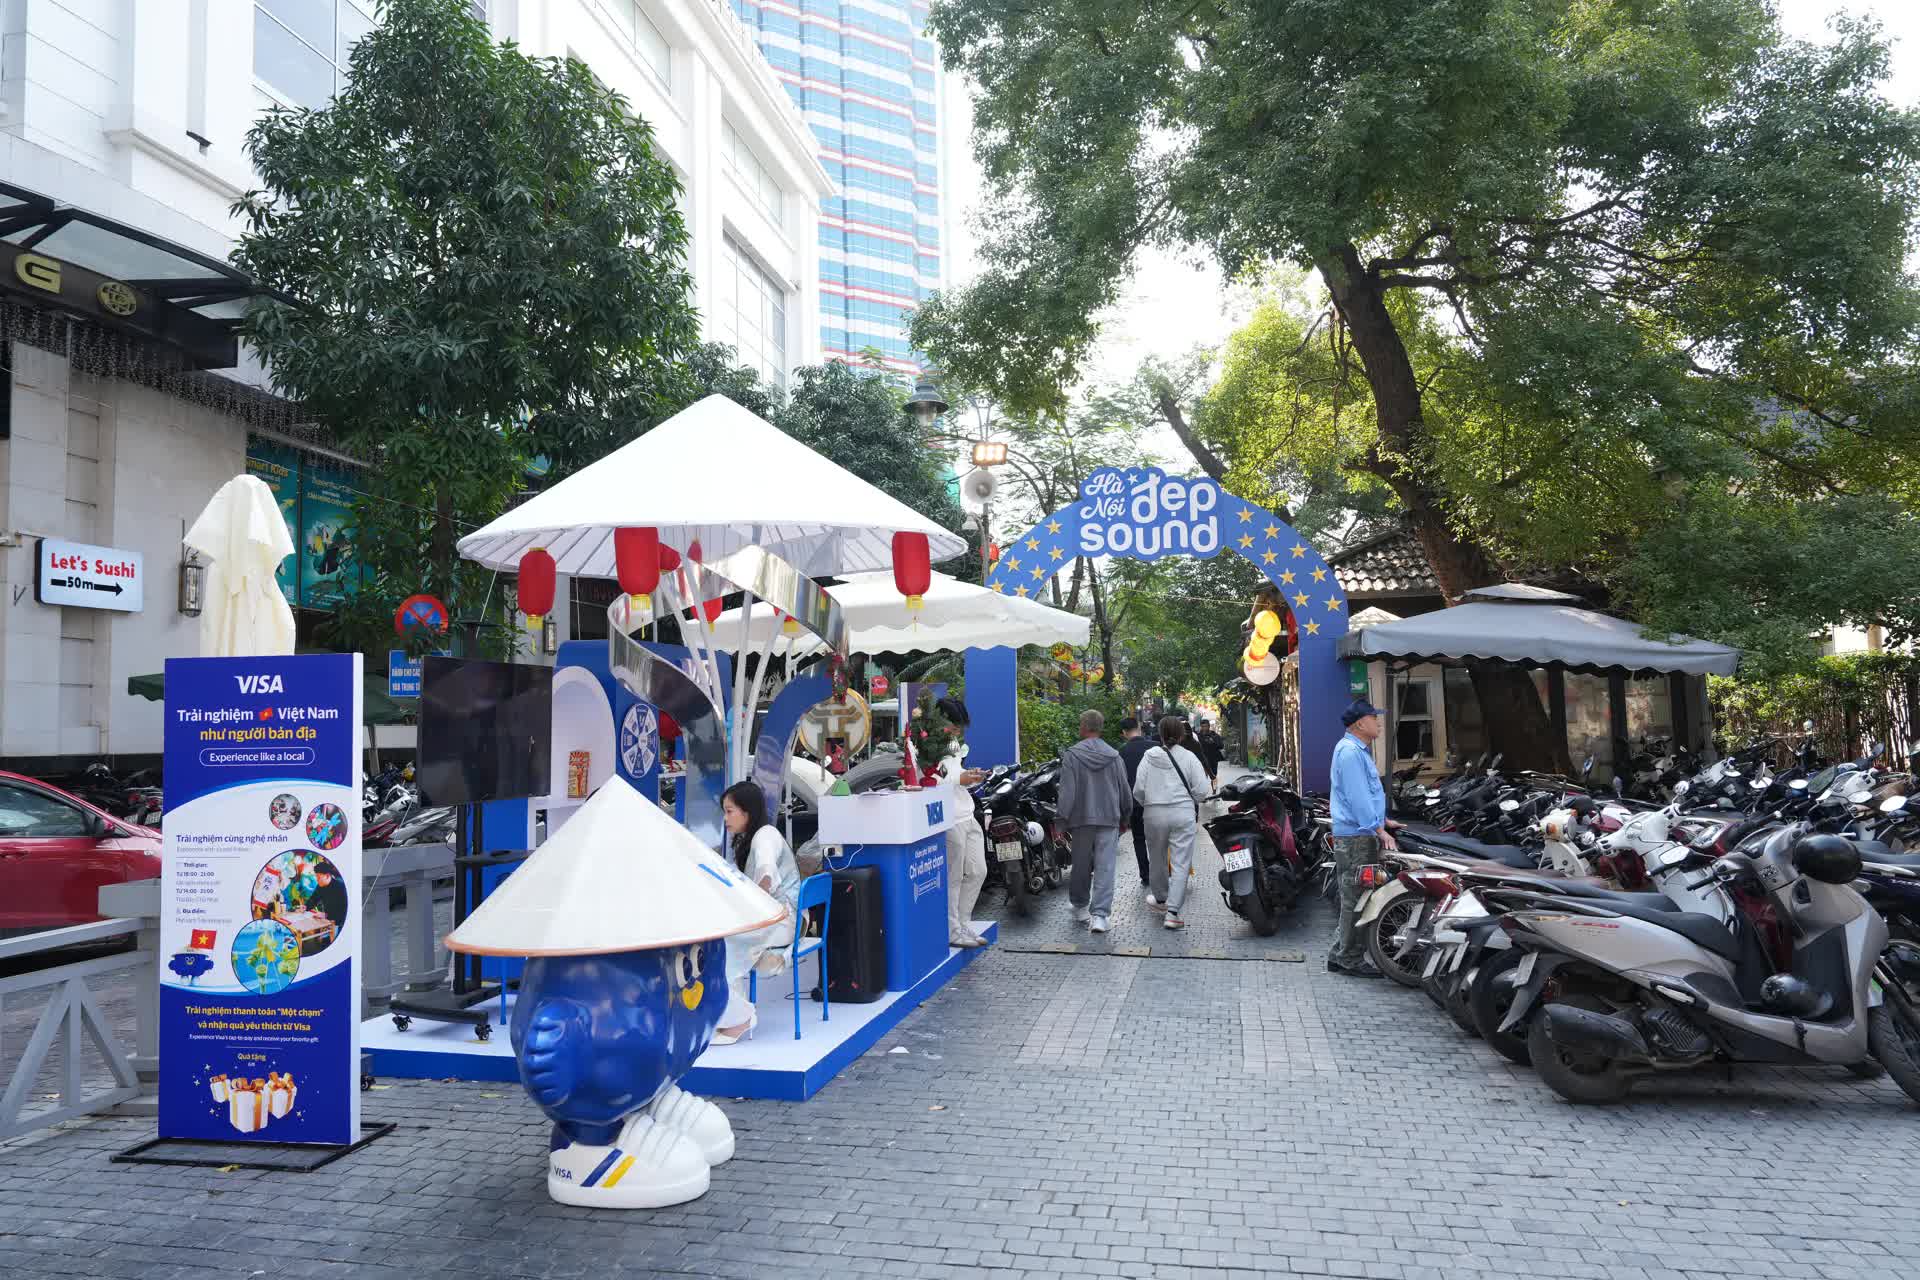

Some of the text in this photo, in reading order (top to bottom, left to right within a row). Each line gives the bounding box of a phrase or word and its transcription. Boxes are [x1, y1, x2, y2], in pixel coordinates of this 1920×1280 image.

[1085, 472, 1125, 496] Hà
[1130, 473, 1217, 524] đẹp
[1080, 497, 1126, 521] Nội
[1080, 515, 1218, 556] sound
[51, 552, 135, 578] Let's Sushi
[67, 576, 94, 590] 50m
[234, 674, 284, 694] VISA
[177, 706, 339, 724] Trải nghiệm Việt Nam
[200, 726, 317, 742] như người bản địa
[209, 752, 259, 763] Experience
[260, 752, 276, 761] like
[283, 751, 305, 761] local
[176, 834, 288, 844] Trải nghiệm cùng nghệ nhân
[185, 1006, 201, 1015] Trải
[202, 1006, 231, 1017] nghiệm
[233, 1007, 256, 1015] thanh
[257, 1008, 276, 1016] toán
[198, 1021, 208, 1029] và
[208, 1021, 228, 1030] nhận
[245, 1023, 260, 1032] yêu
[261, 1022, 282, 1030] thích
[293, 1023, 311, 1031] Visa
[553, 1165, 573, 1180] VISA
